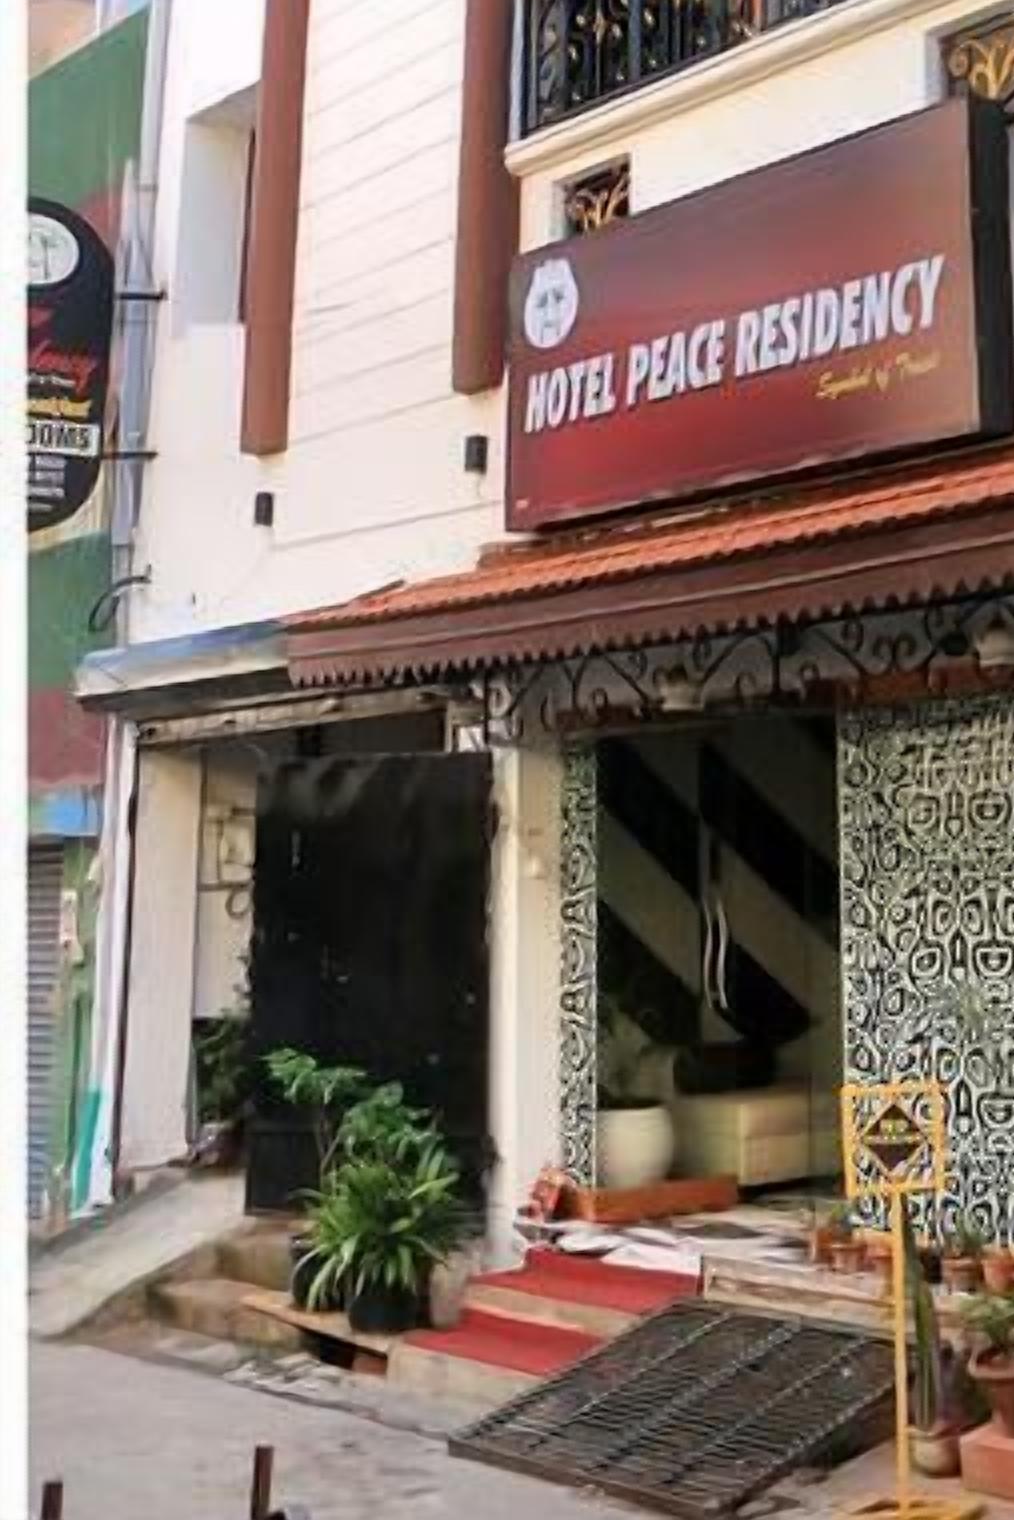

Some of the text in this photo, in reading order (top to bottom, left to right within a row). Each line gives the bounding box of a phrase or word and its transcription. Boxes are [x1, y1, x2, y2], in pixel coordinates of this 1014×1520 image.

[524, 352, 616, 434] HOTEL
[626, 318, 726, 407] PEACE
[734, 253, 945, 377] RESIDENCY
